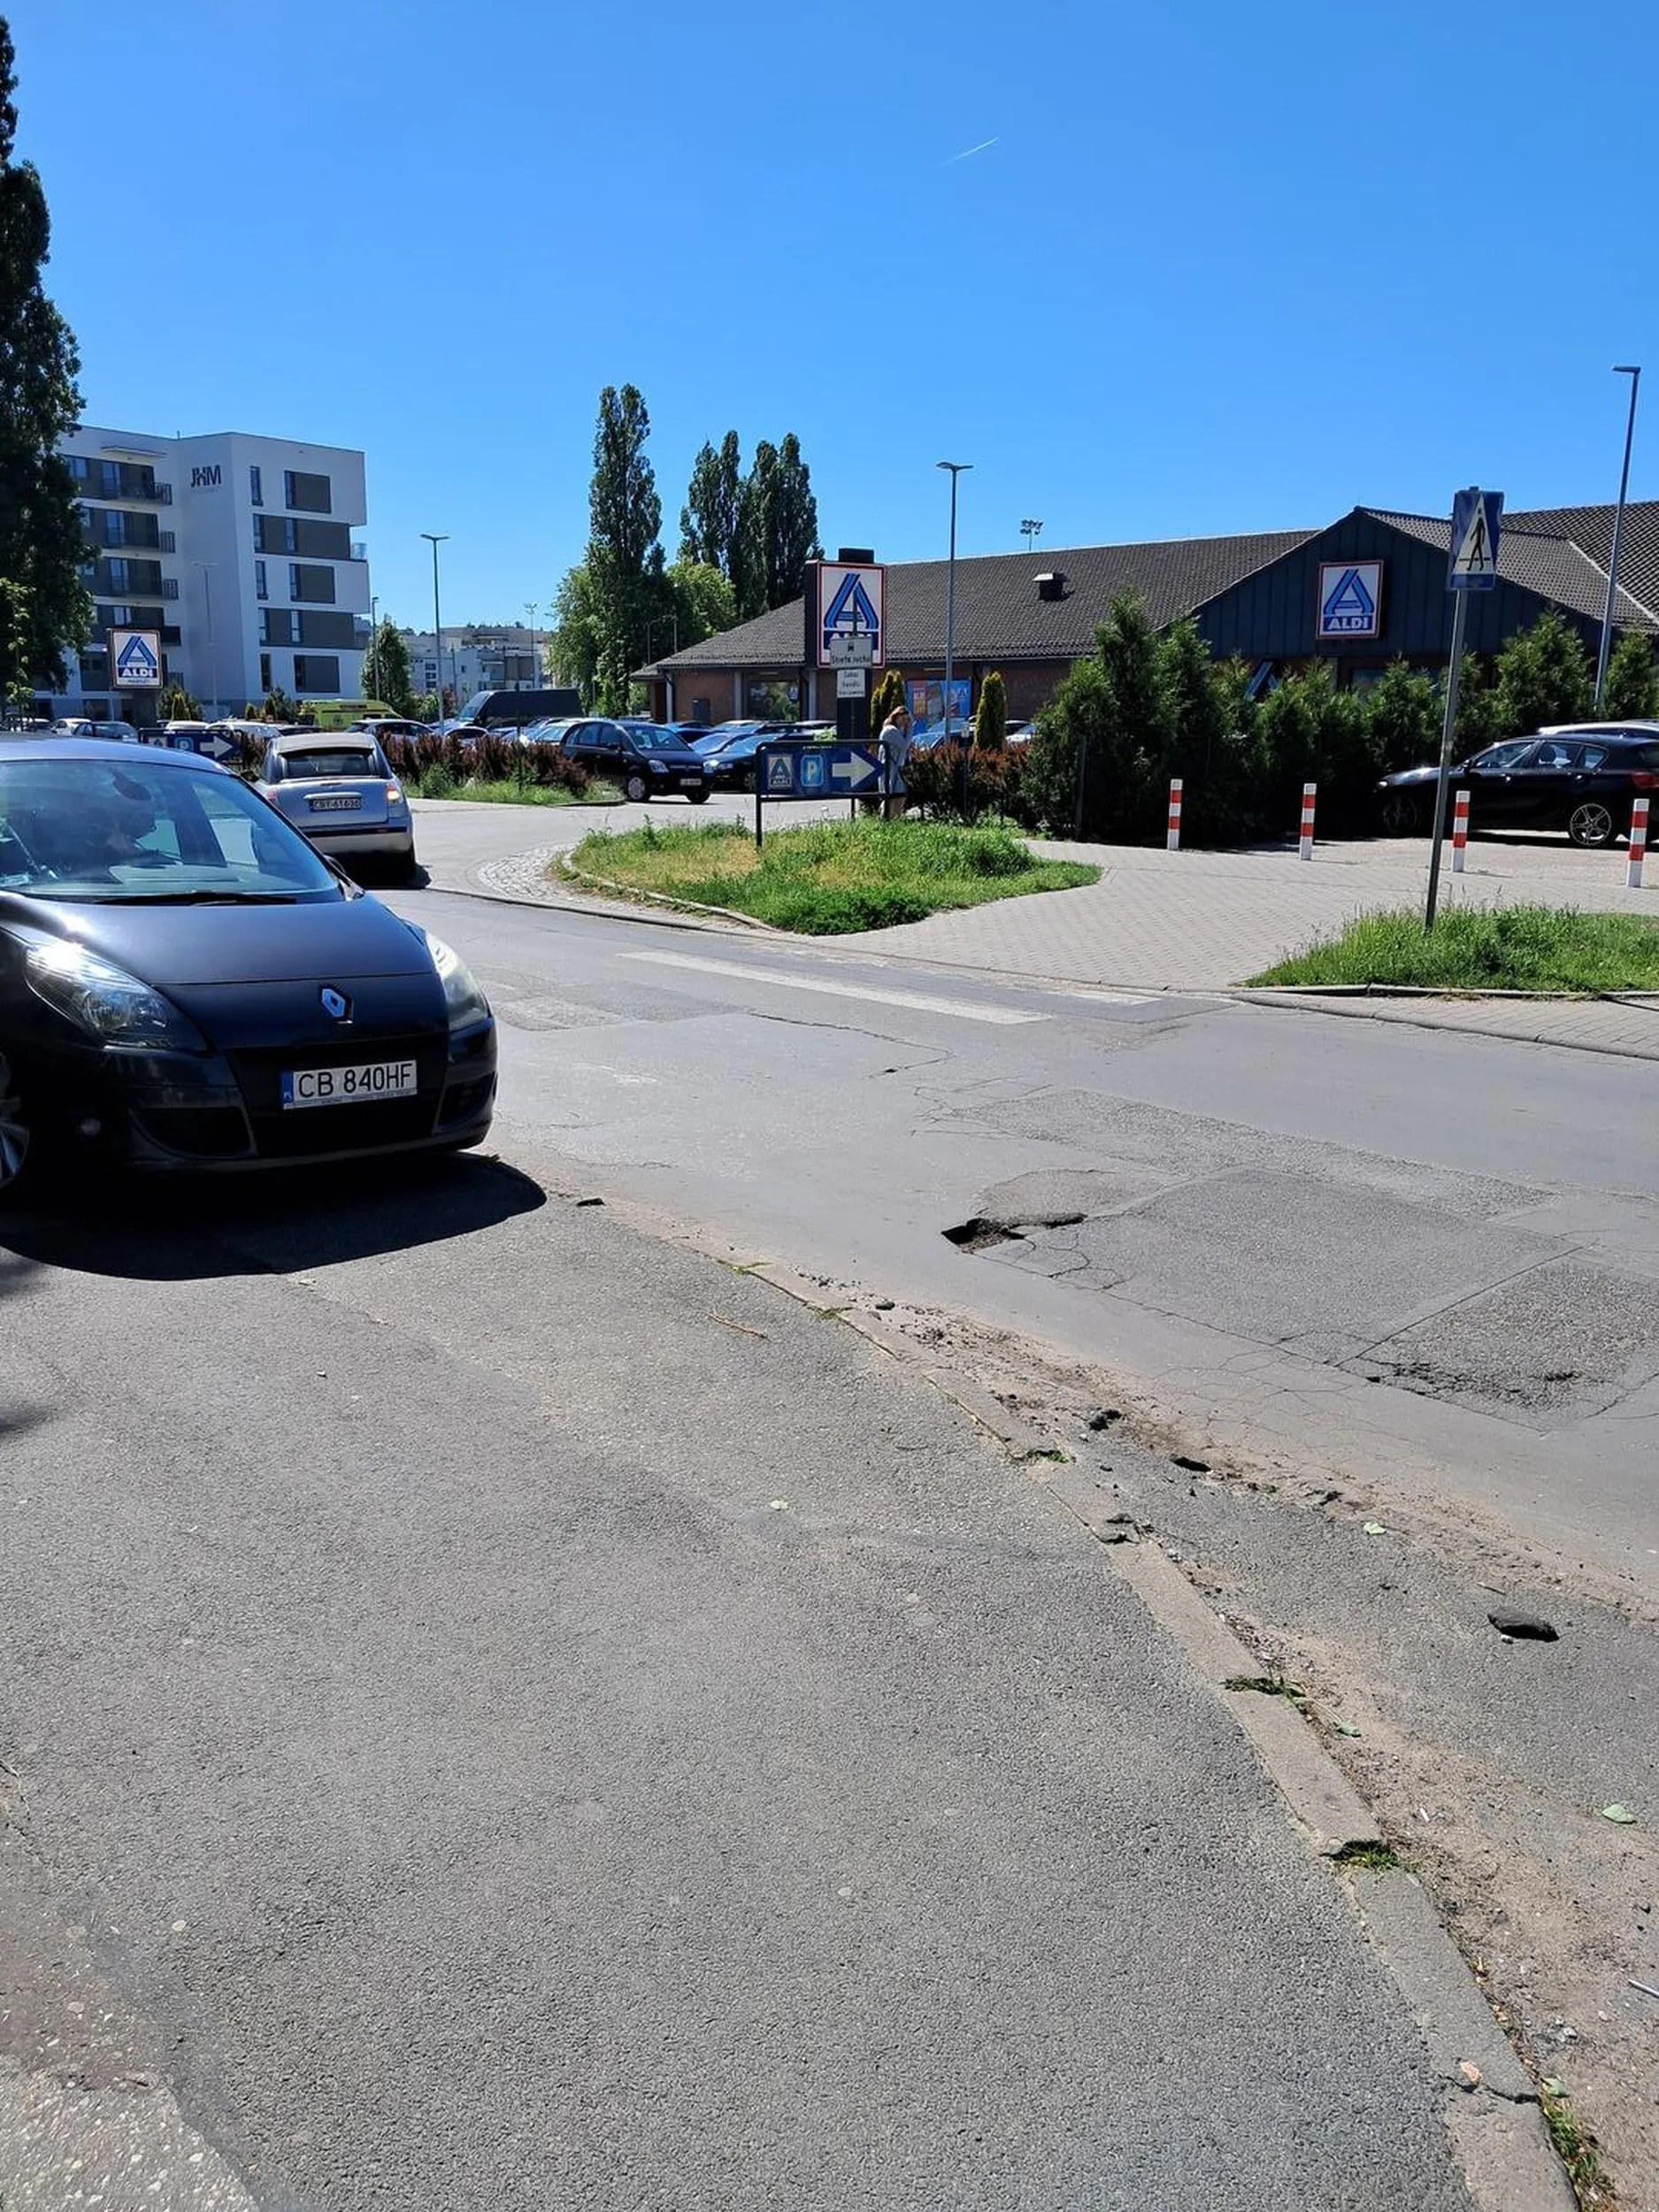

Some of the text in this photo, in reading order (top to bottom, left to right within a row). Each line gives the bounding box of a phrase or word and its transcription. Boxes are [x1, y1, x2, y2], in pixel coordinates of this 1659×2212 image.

[191, 465, 222, 488] JHM
[1327, 617, 1369, 630] ALDI
[121, 667, 154, 678] ALDI
[298, 1071, 334, 1098] CB
[343, 1063, 413, 1094] 840HF
